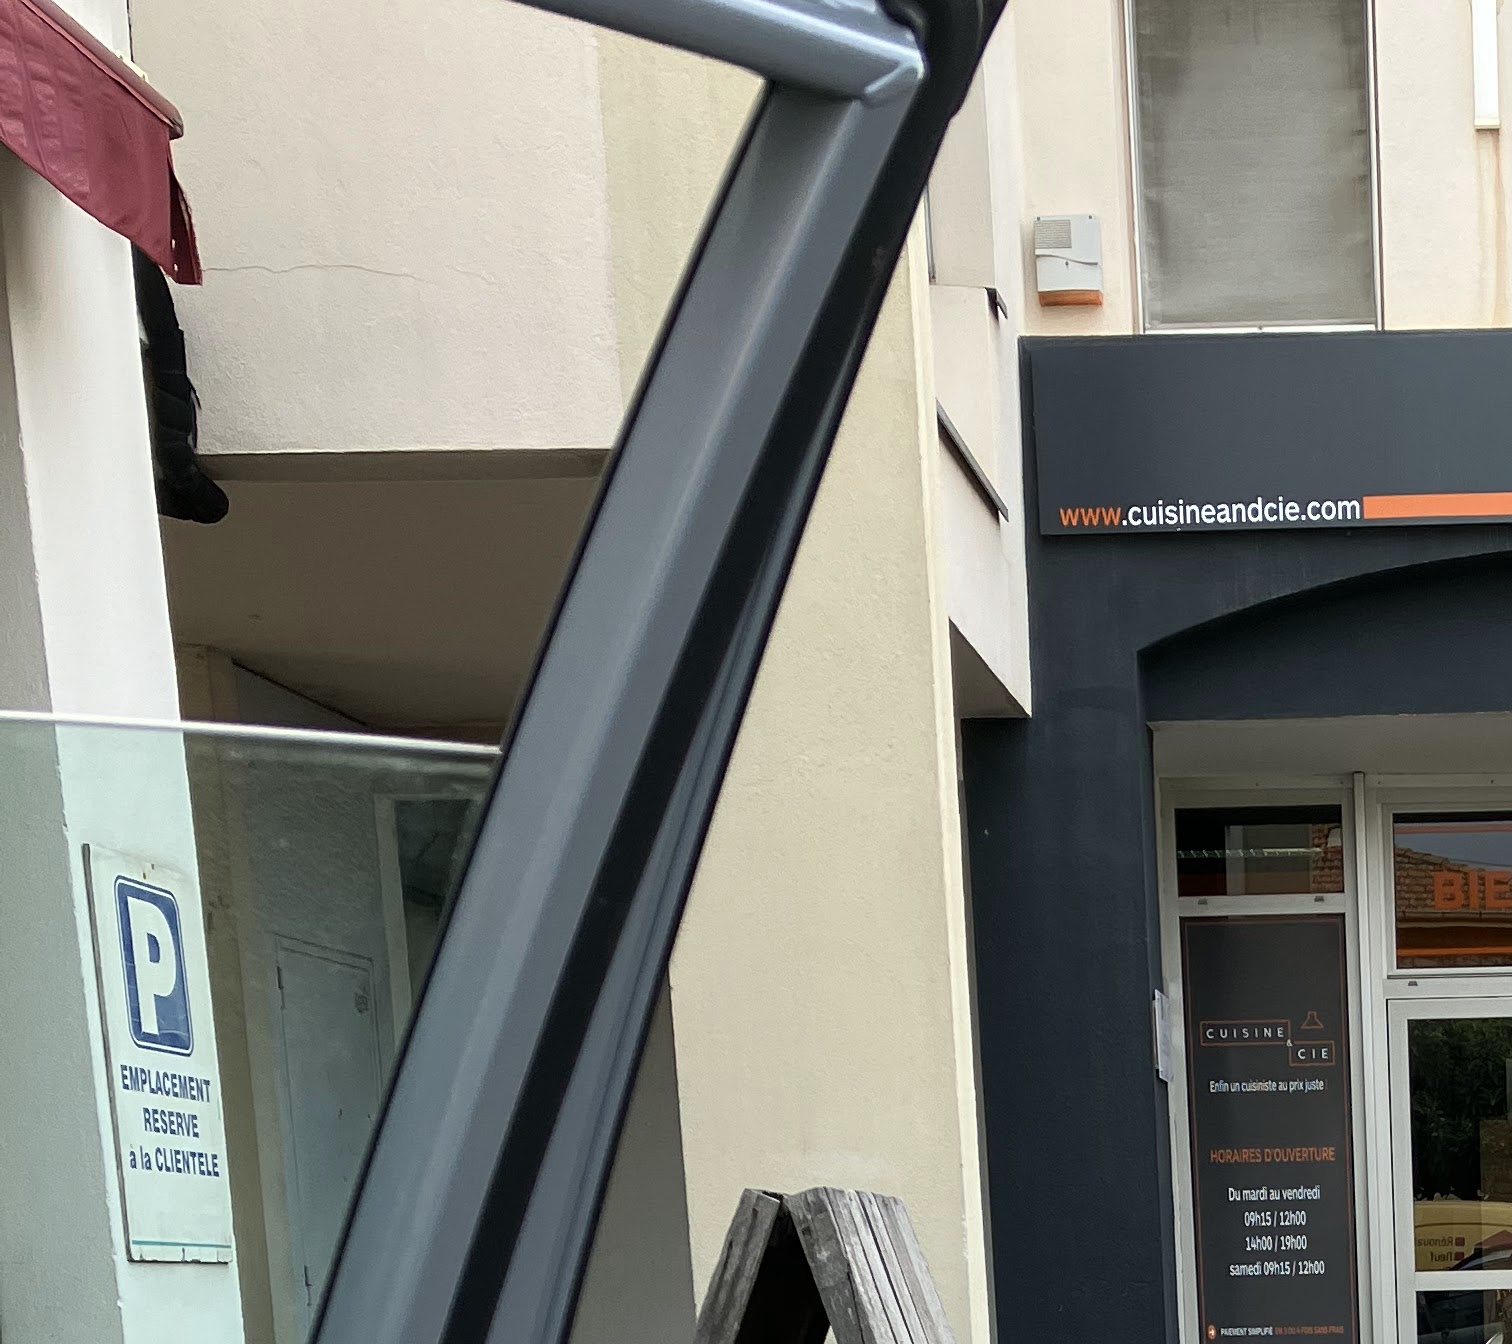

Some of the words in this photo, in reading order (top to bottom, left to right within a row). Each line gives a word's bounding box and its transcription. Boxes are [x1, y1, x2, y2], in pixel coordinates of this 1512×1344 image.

[1060, 497, 1361, 526] www.cuisineandcie.com
[126, 896, 177, 1035] P
[1206, 1027, 1285, 1039] CUISINE
[1297, 1048, 1329, 1059] CIE
[120, 1064, 210, 1102] EMPLACEMENT
[1230, 1081, 1240, 1092] un
[1278, 1081, 1288, 1091] au
[1289, 1079, 1304, 1093] prix
[1305, 1078, 1324, 1093] juste
[143, 1107, 199, 1138] RESERVE
[129, 1144, 137, 1169] à
[140, 1145, 151, 1170] la
[155, 1147, 219, 1177] CLIENTELE
[1210, 1148, 1261, 1163] HORAIRES
[1264, 1147, 1335, 1162] D'OUVERTURE
[1228, 1187, 1241, 1201] Du
[1243, 1186, 1268, 1201] mardi
[1269, 1189, 1280, 1200] au
[1282, 1185, 1320, 1200] vendredi
[1244, 1211, 1271, 1226] 09h15
[1279, 1210, 1307, 1226] 12h00
[1245, 1236, 1272, 1251] 14h00
[1280, 1235, 1307, 1250] 19h00
[1230, 1261, 1262, 1276] samedi
[1263, 1261, 1290, 1275] 09h15
[1298, 1261, 1325, 1275] 12h00
